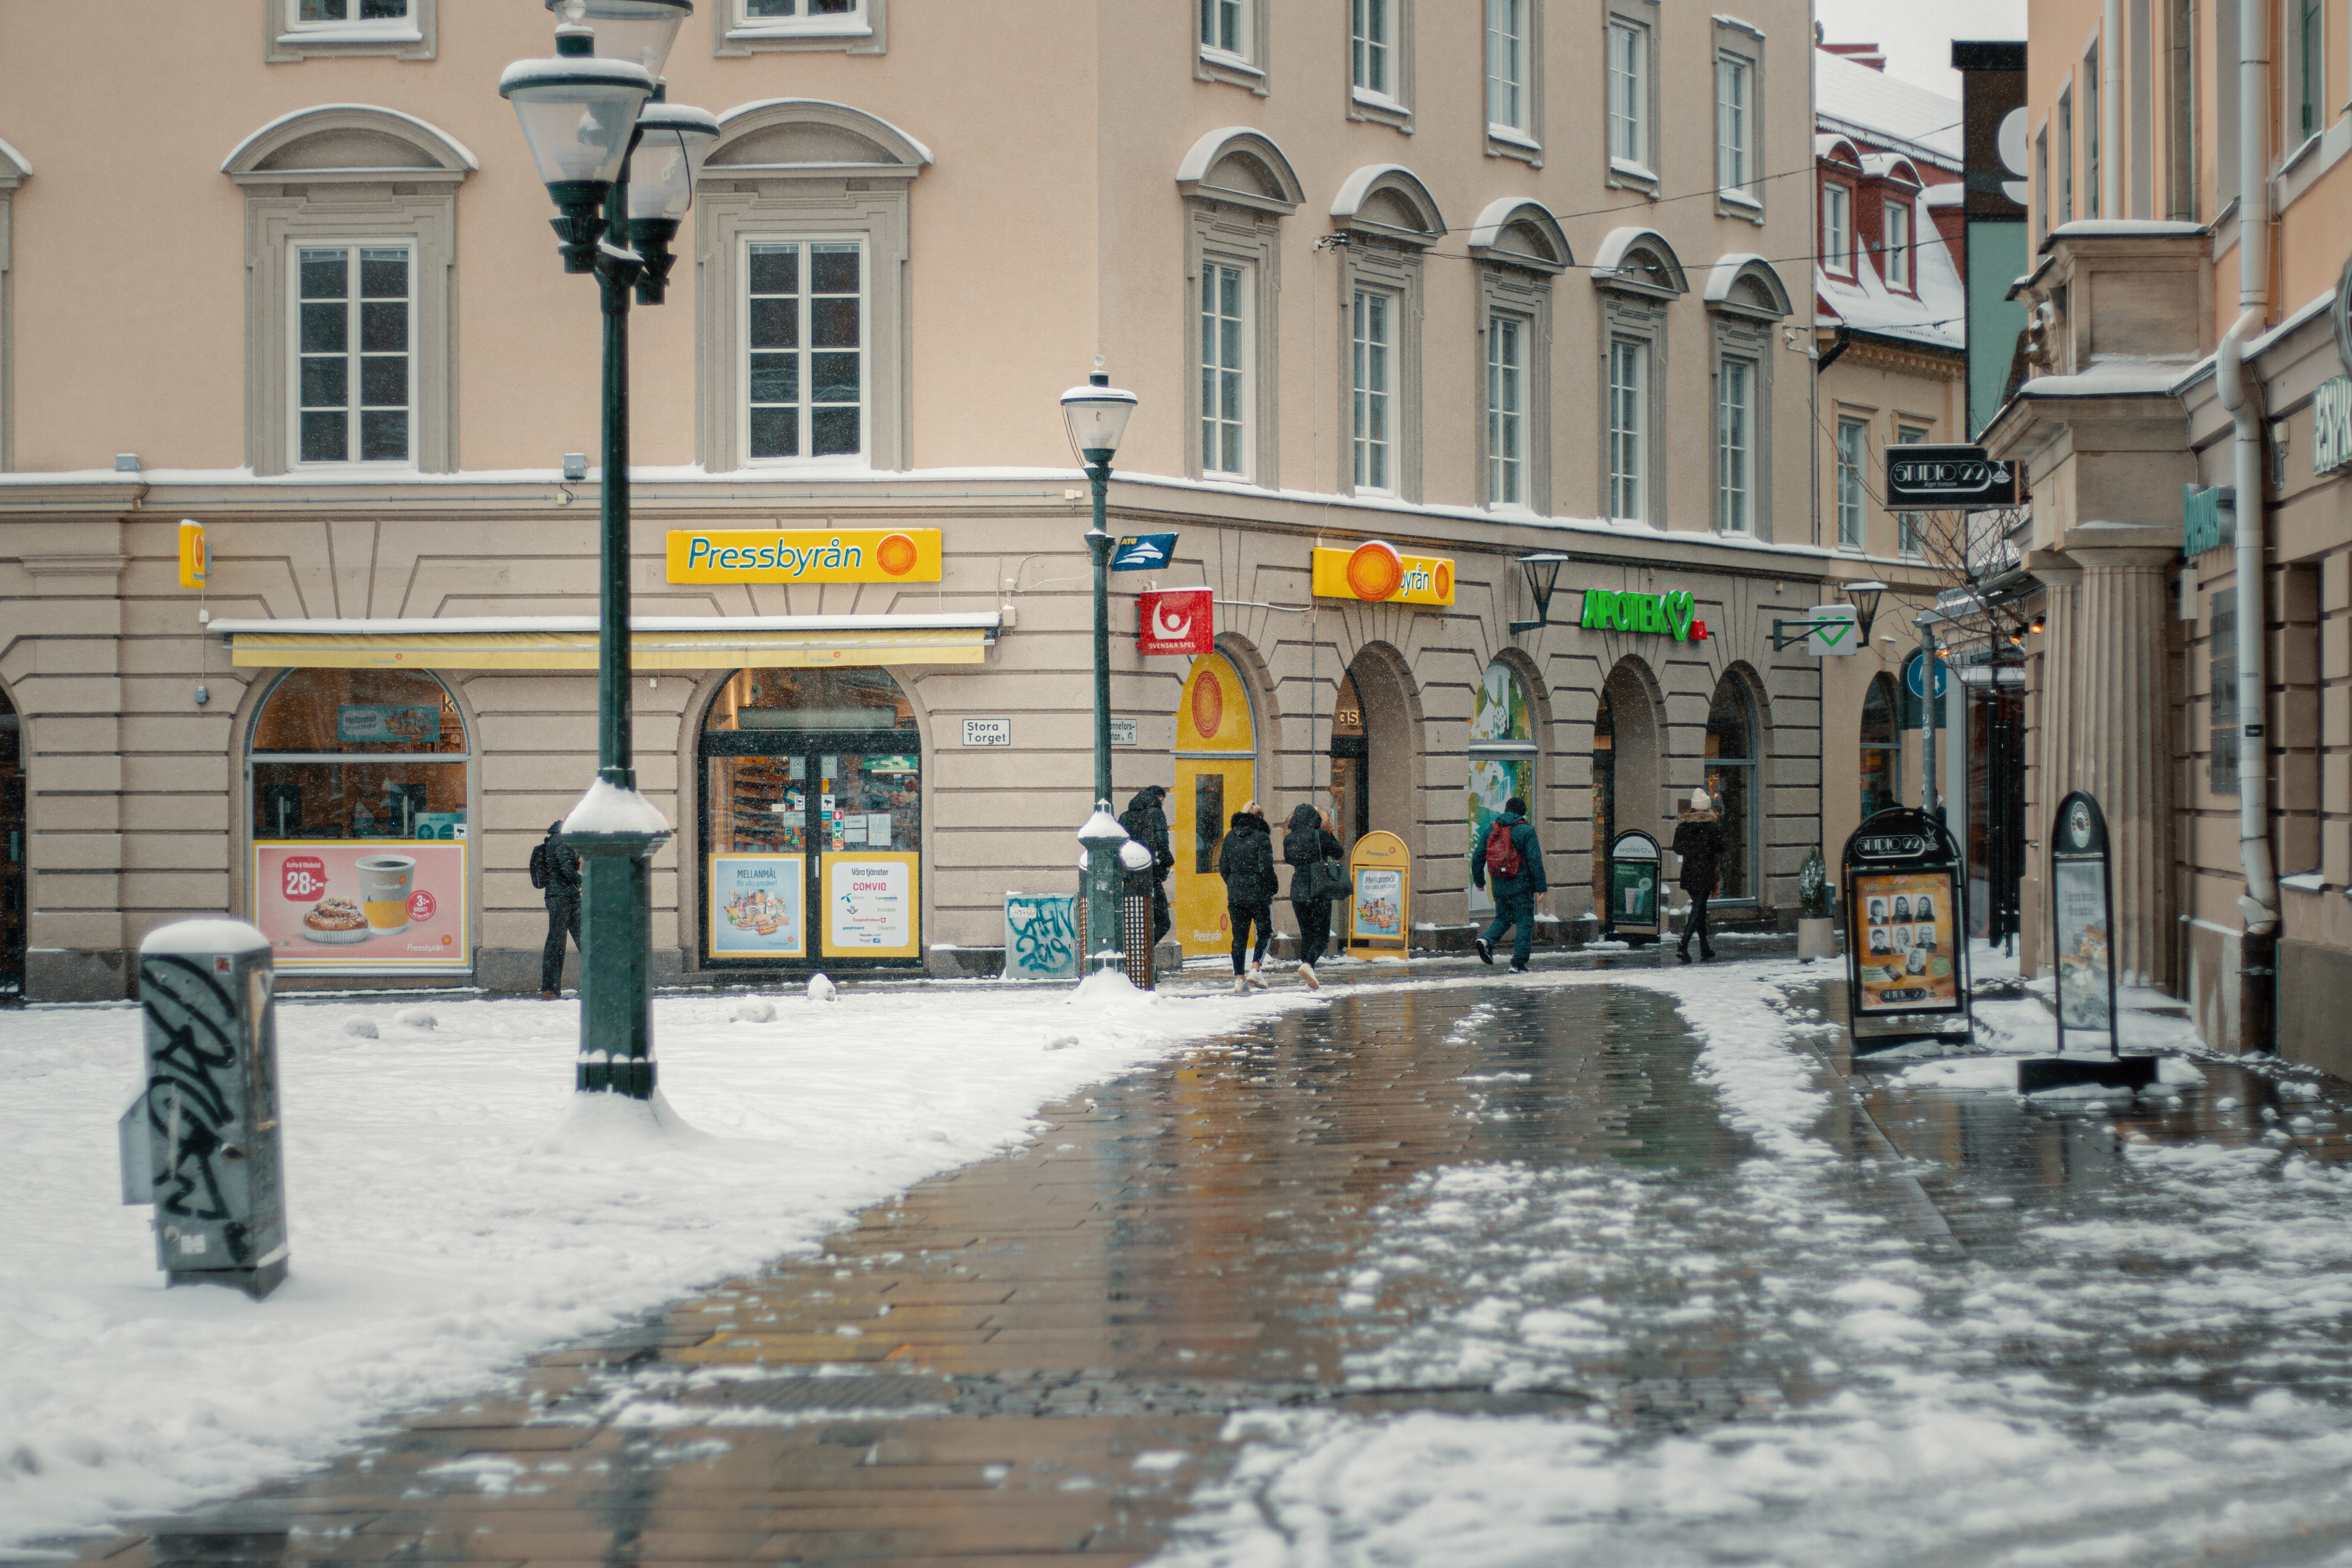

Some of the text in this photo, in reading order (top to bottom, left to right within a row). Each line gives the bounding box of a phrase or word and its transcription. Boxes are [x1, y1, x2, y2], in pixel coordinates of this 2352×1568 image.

[1895, 463, 1984, 482] STUDIO 22
[688, 537, 862, 577] Pressbyrån
[1581, 589, 1669, 634] APOTEK
[968, 722, 998, 731] Stora
[968, 733, 1006, 744] Torget
[1859, 837, 1920, 851] STUDIO 22
[738, 868, 777, 878] MELLANMÅL
[866, 868, 889, 877] tjänster
[286, 871, 324, 894] 28:-
[1366, 874, 1395, 884] Mellanmål
[853, 882, 887, 891] COMVIQ
[417, 895, 429, 906] 3:-
[1194, 930, 1222, 944] Pressbyrån
[407, 943, 443, 952] Pressbyrån
